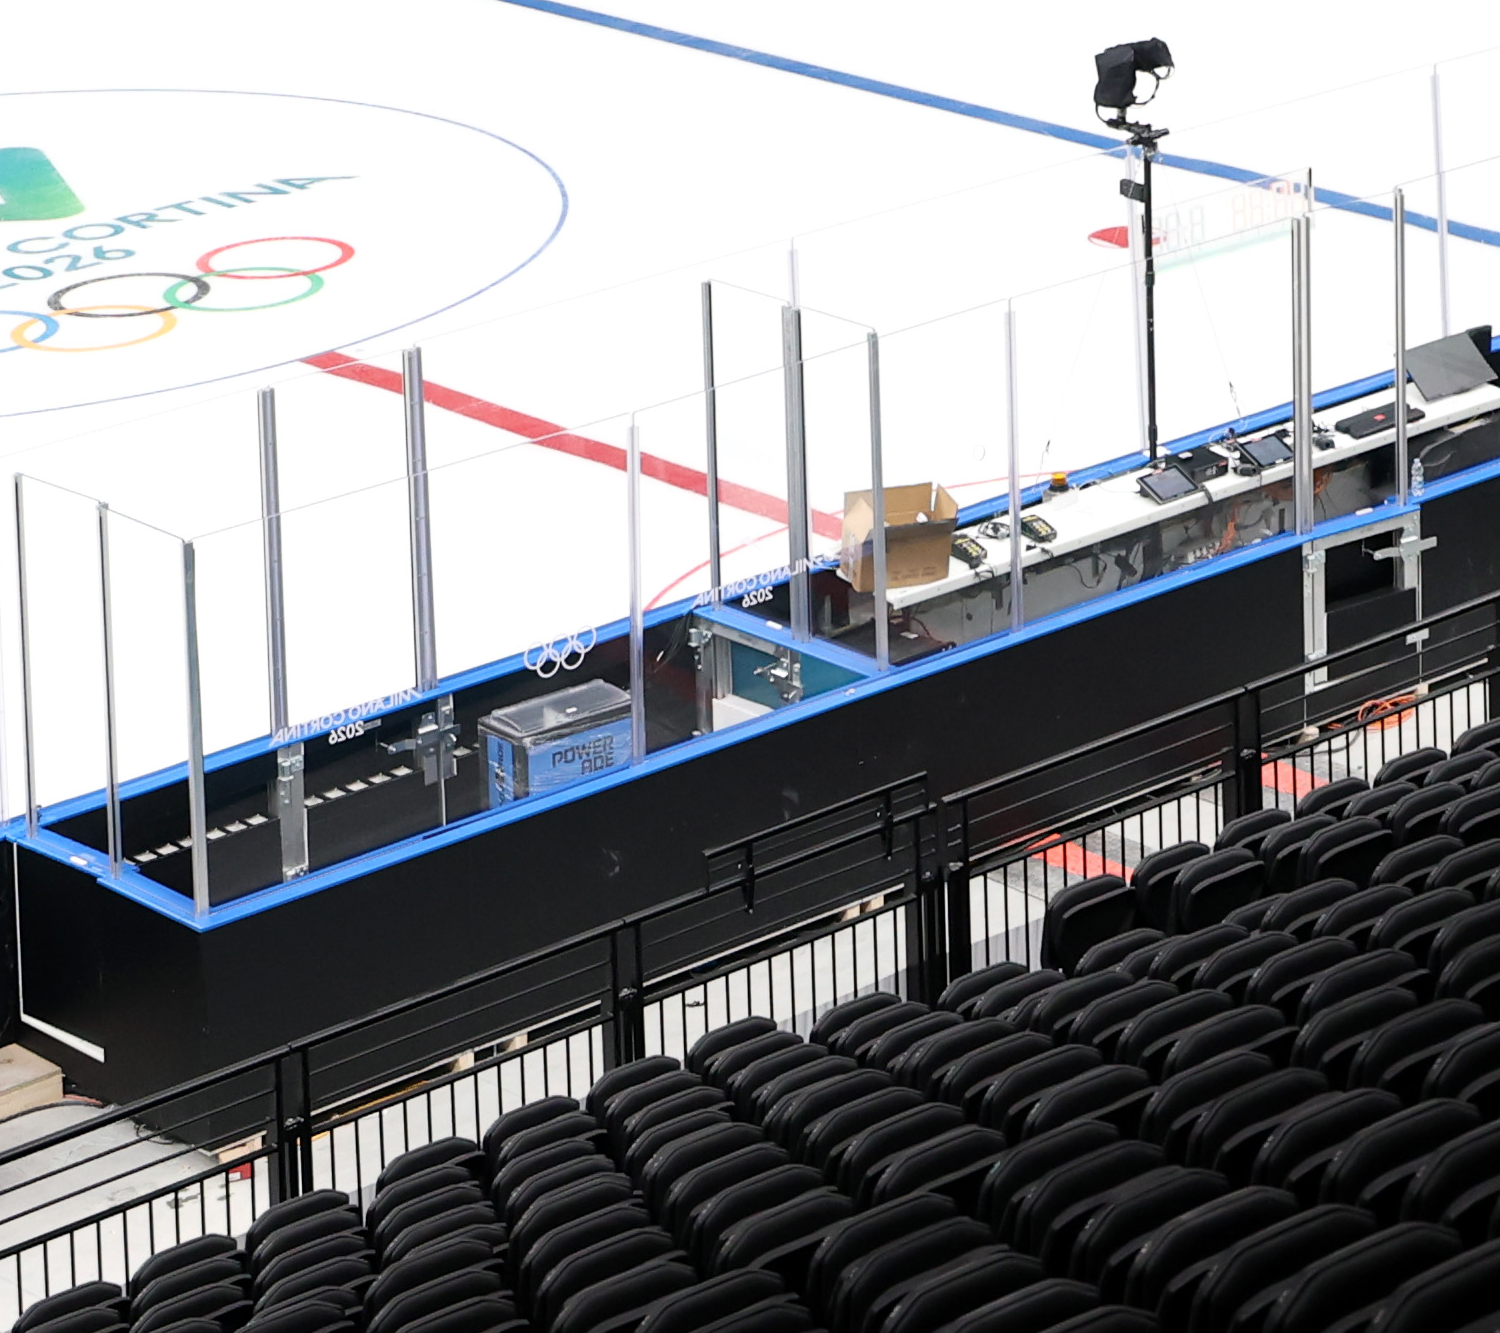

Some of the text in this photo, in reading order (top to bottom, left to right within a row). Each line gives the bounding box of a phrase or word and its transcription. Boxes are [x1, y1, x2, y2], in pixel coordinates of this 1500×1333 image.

[6, 175, 360, 254] CORTINA
[552, 735, 614, 767] POWER
[581, 753, 614, 775] ADE
